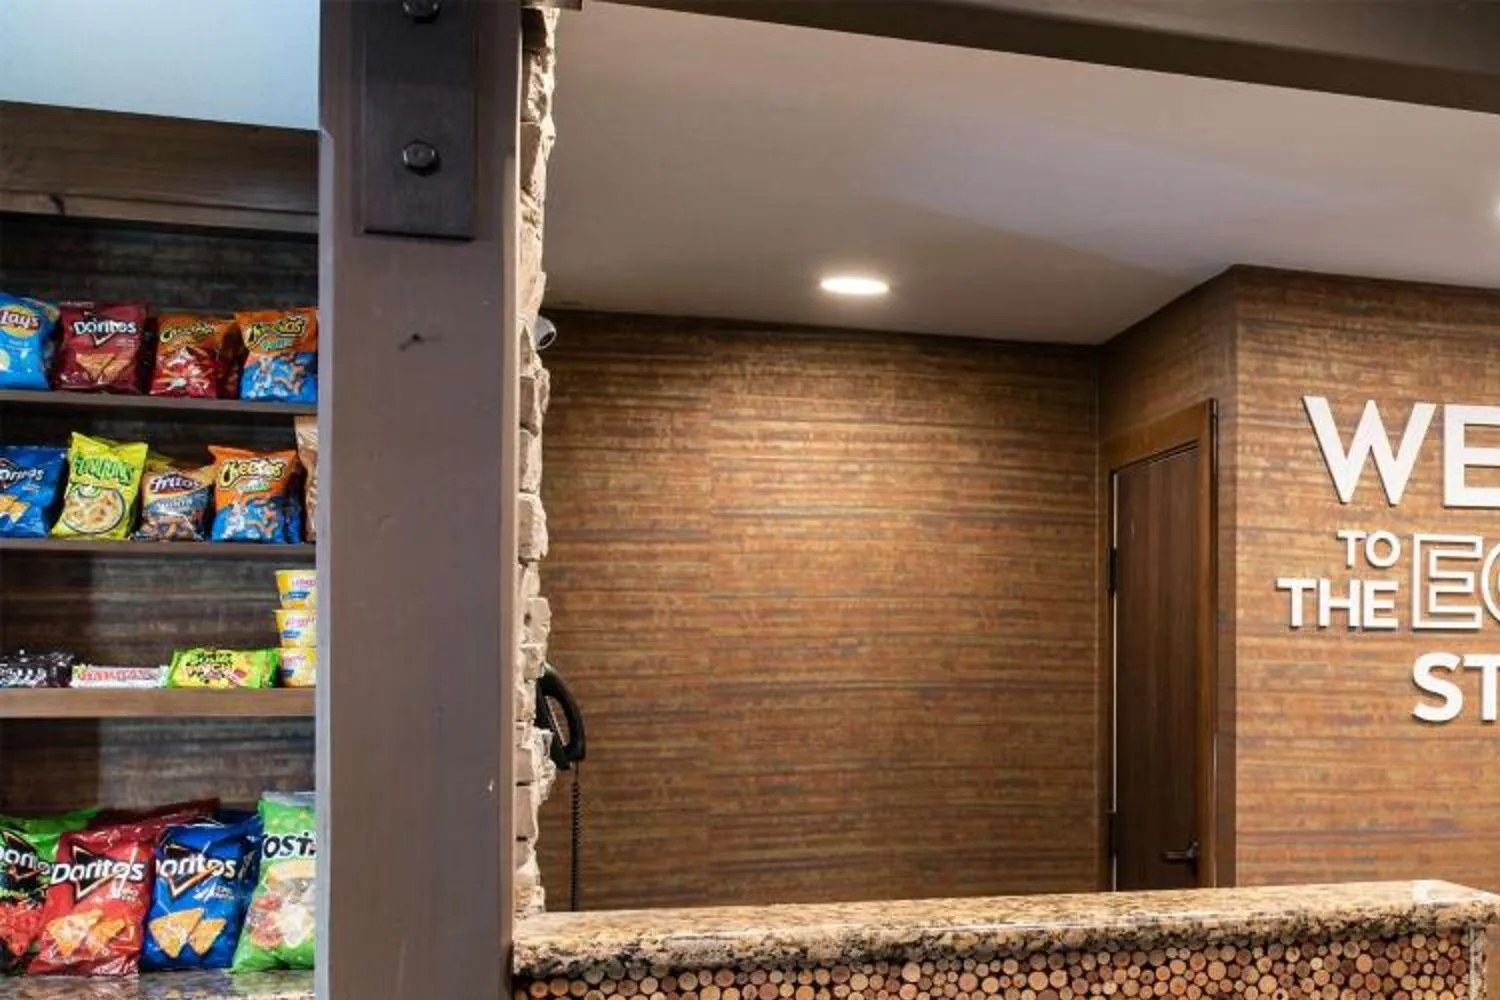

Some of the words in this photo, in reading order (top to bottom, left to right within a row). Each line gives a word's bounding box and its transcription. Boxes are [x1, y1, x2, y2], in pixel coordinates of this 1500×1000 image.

[73, 318, 137, 335] Doritos
[1337, 529, 1400, 569] TO
[1276, 576, 1399, 631] THE
[51, 860, 145, 884] Doritos
[156, 853, 237, 879] oritos
